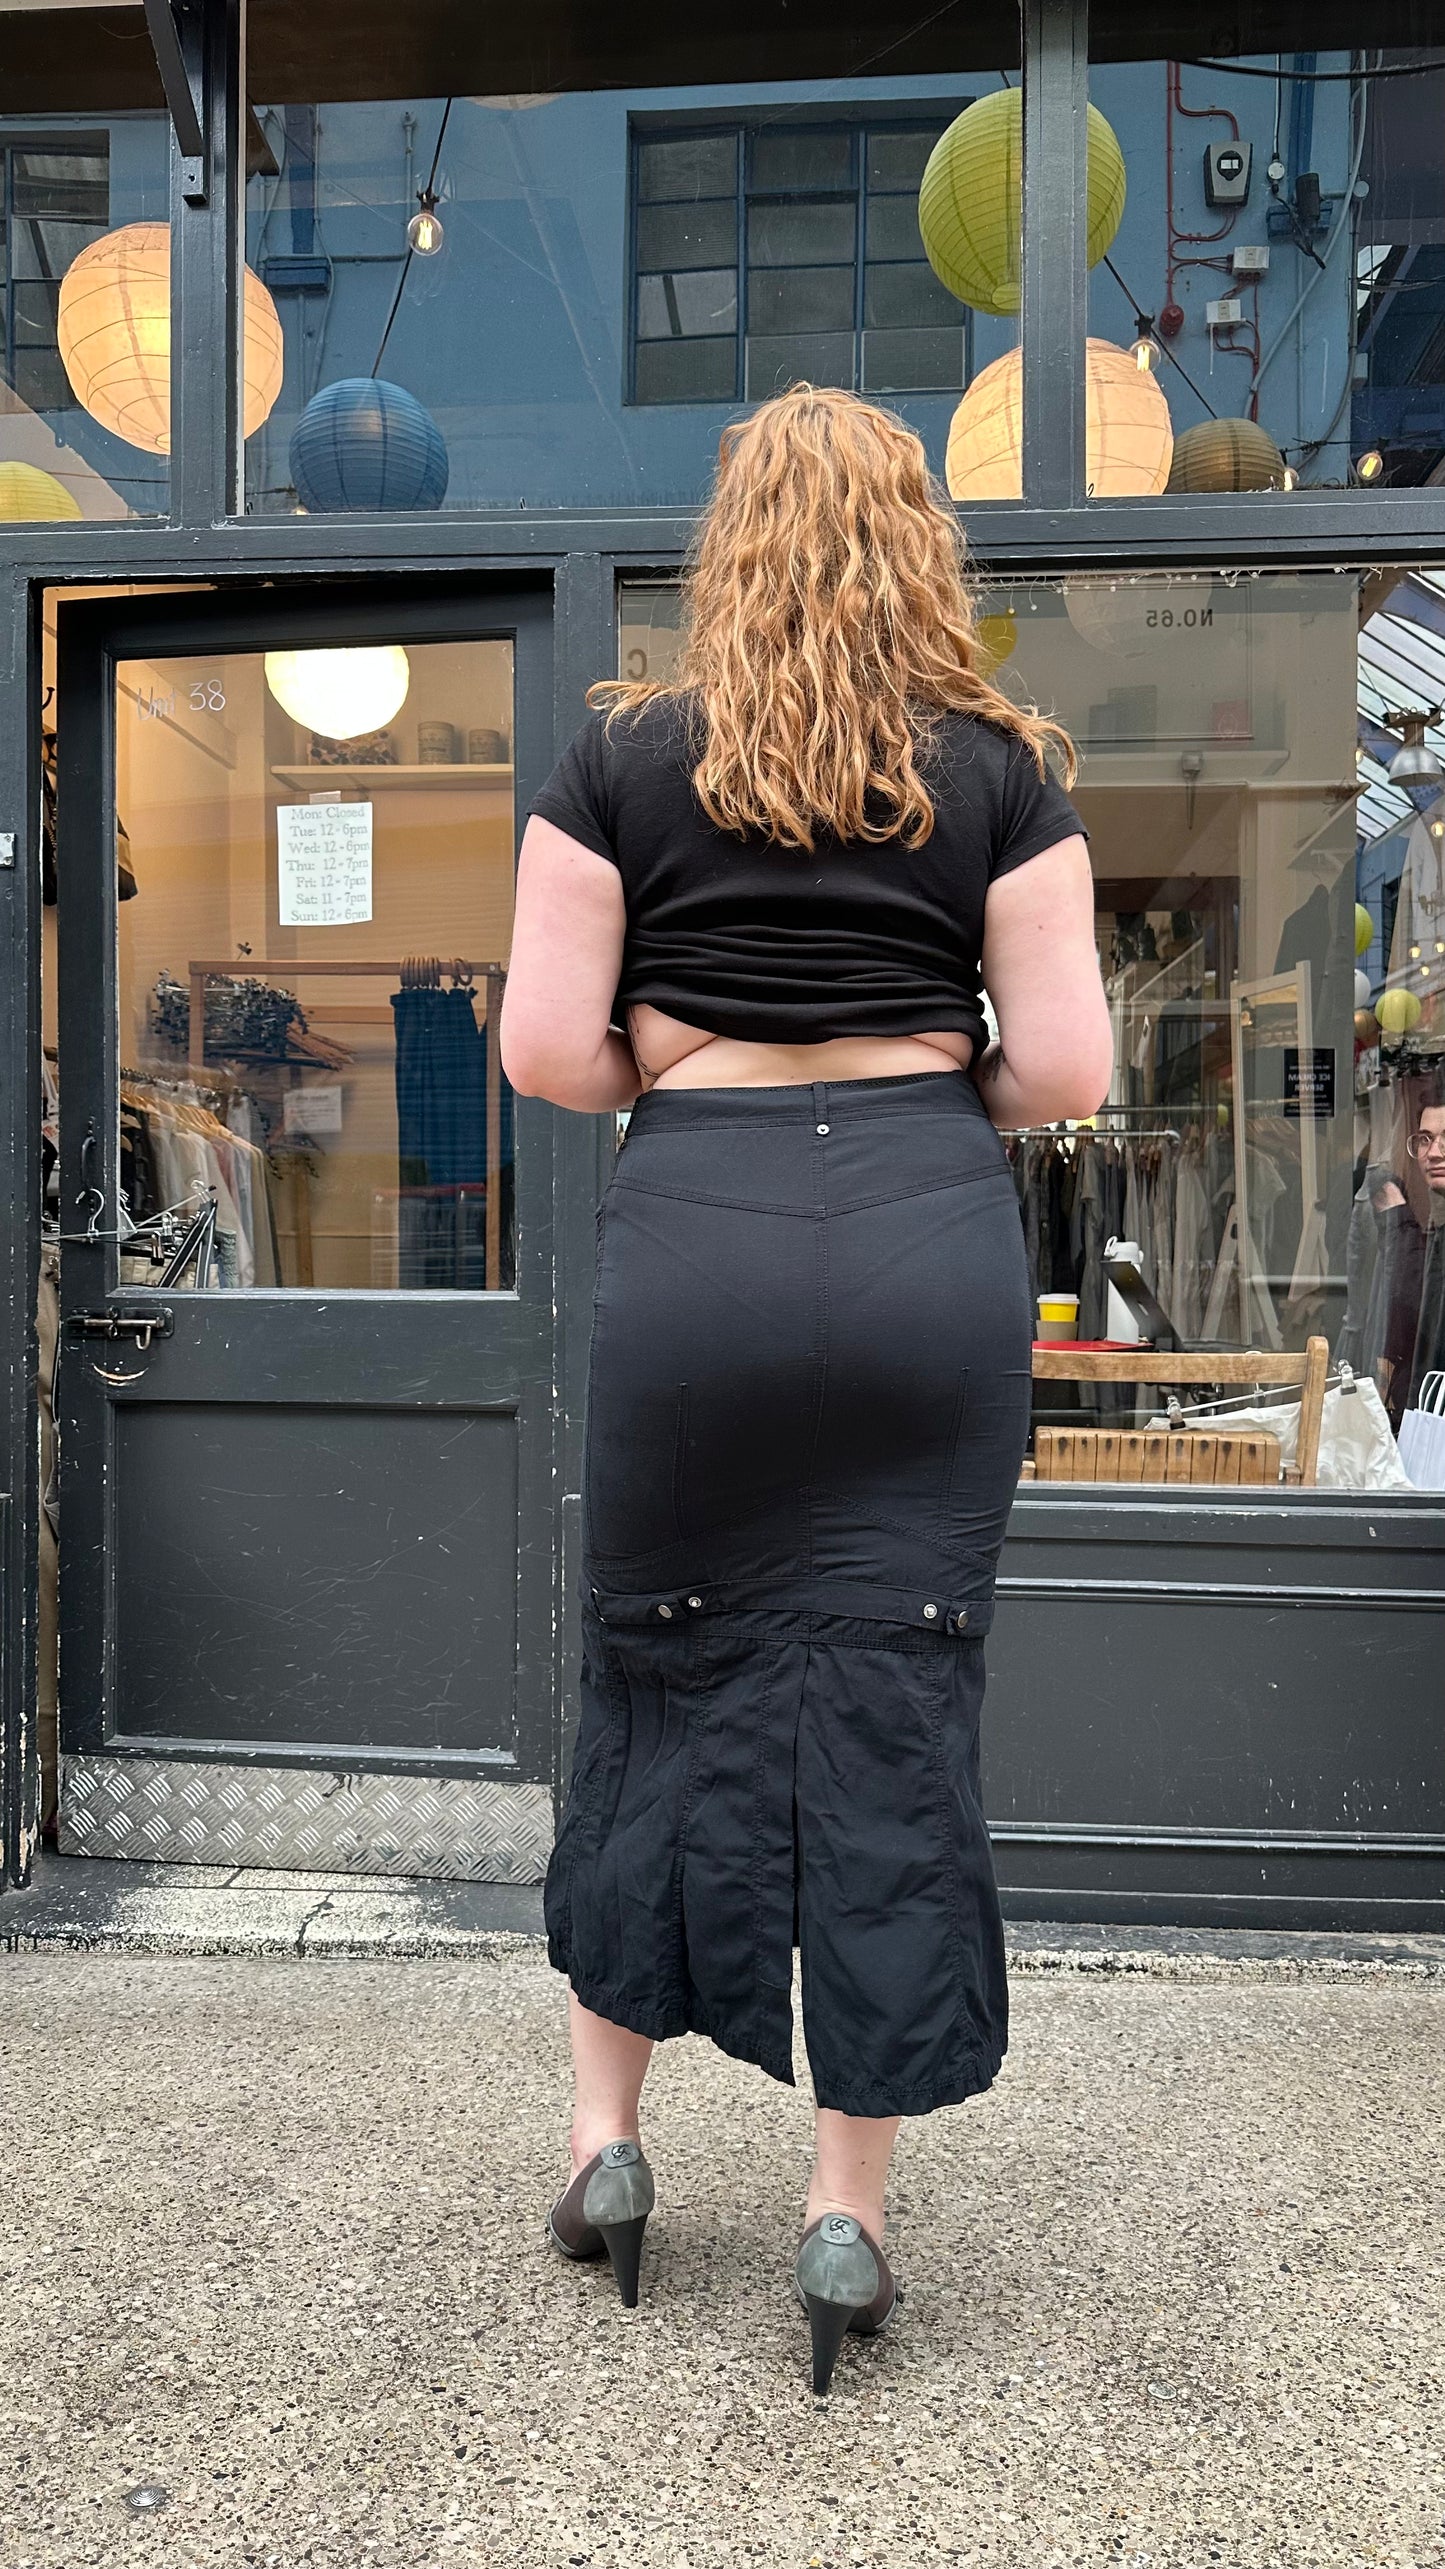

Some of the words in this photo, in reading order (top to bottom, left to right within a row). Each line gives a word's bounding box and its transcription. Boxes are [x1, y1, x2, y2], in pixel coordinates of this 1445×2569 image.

[189, 679, 226, 711] 38
[291, 808, 322, 820] Mon:
[326, 806, 365, 819] Closed
[289, 825, 317, 837] Tue:
[321, 823, 334, 836] 12
[343, 823, 368, 838] 6pm
[288, 841, 321, 854] Wed:
[324, 840, 337, 853] 12
[346, 840, 370, 855] 6pm
[285, 859, 316, 872] Thu:
[323, 857, 337, 870] 12
[346, 857, 369, 872] 7pm
[296, 876, 317, 888] Fri:
[321, 874, 334, 887] 12
[343, 875, 367, 890] 7pm
[296, 893, 318, 905] Sat:
[322, 892, 333, 904] 11
[344, 892, 367, 906] 7pm
[291, 909, 318, 921] Sun:
[322, 909, 336, 921] 12
[345, 908, 368, 921] 6pm
